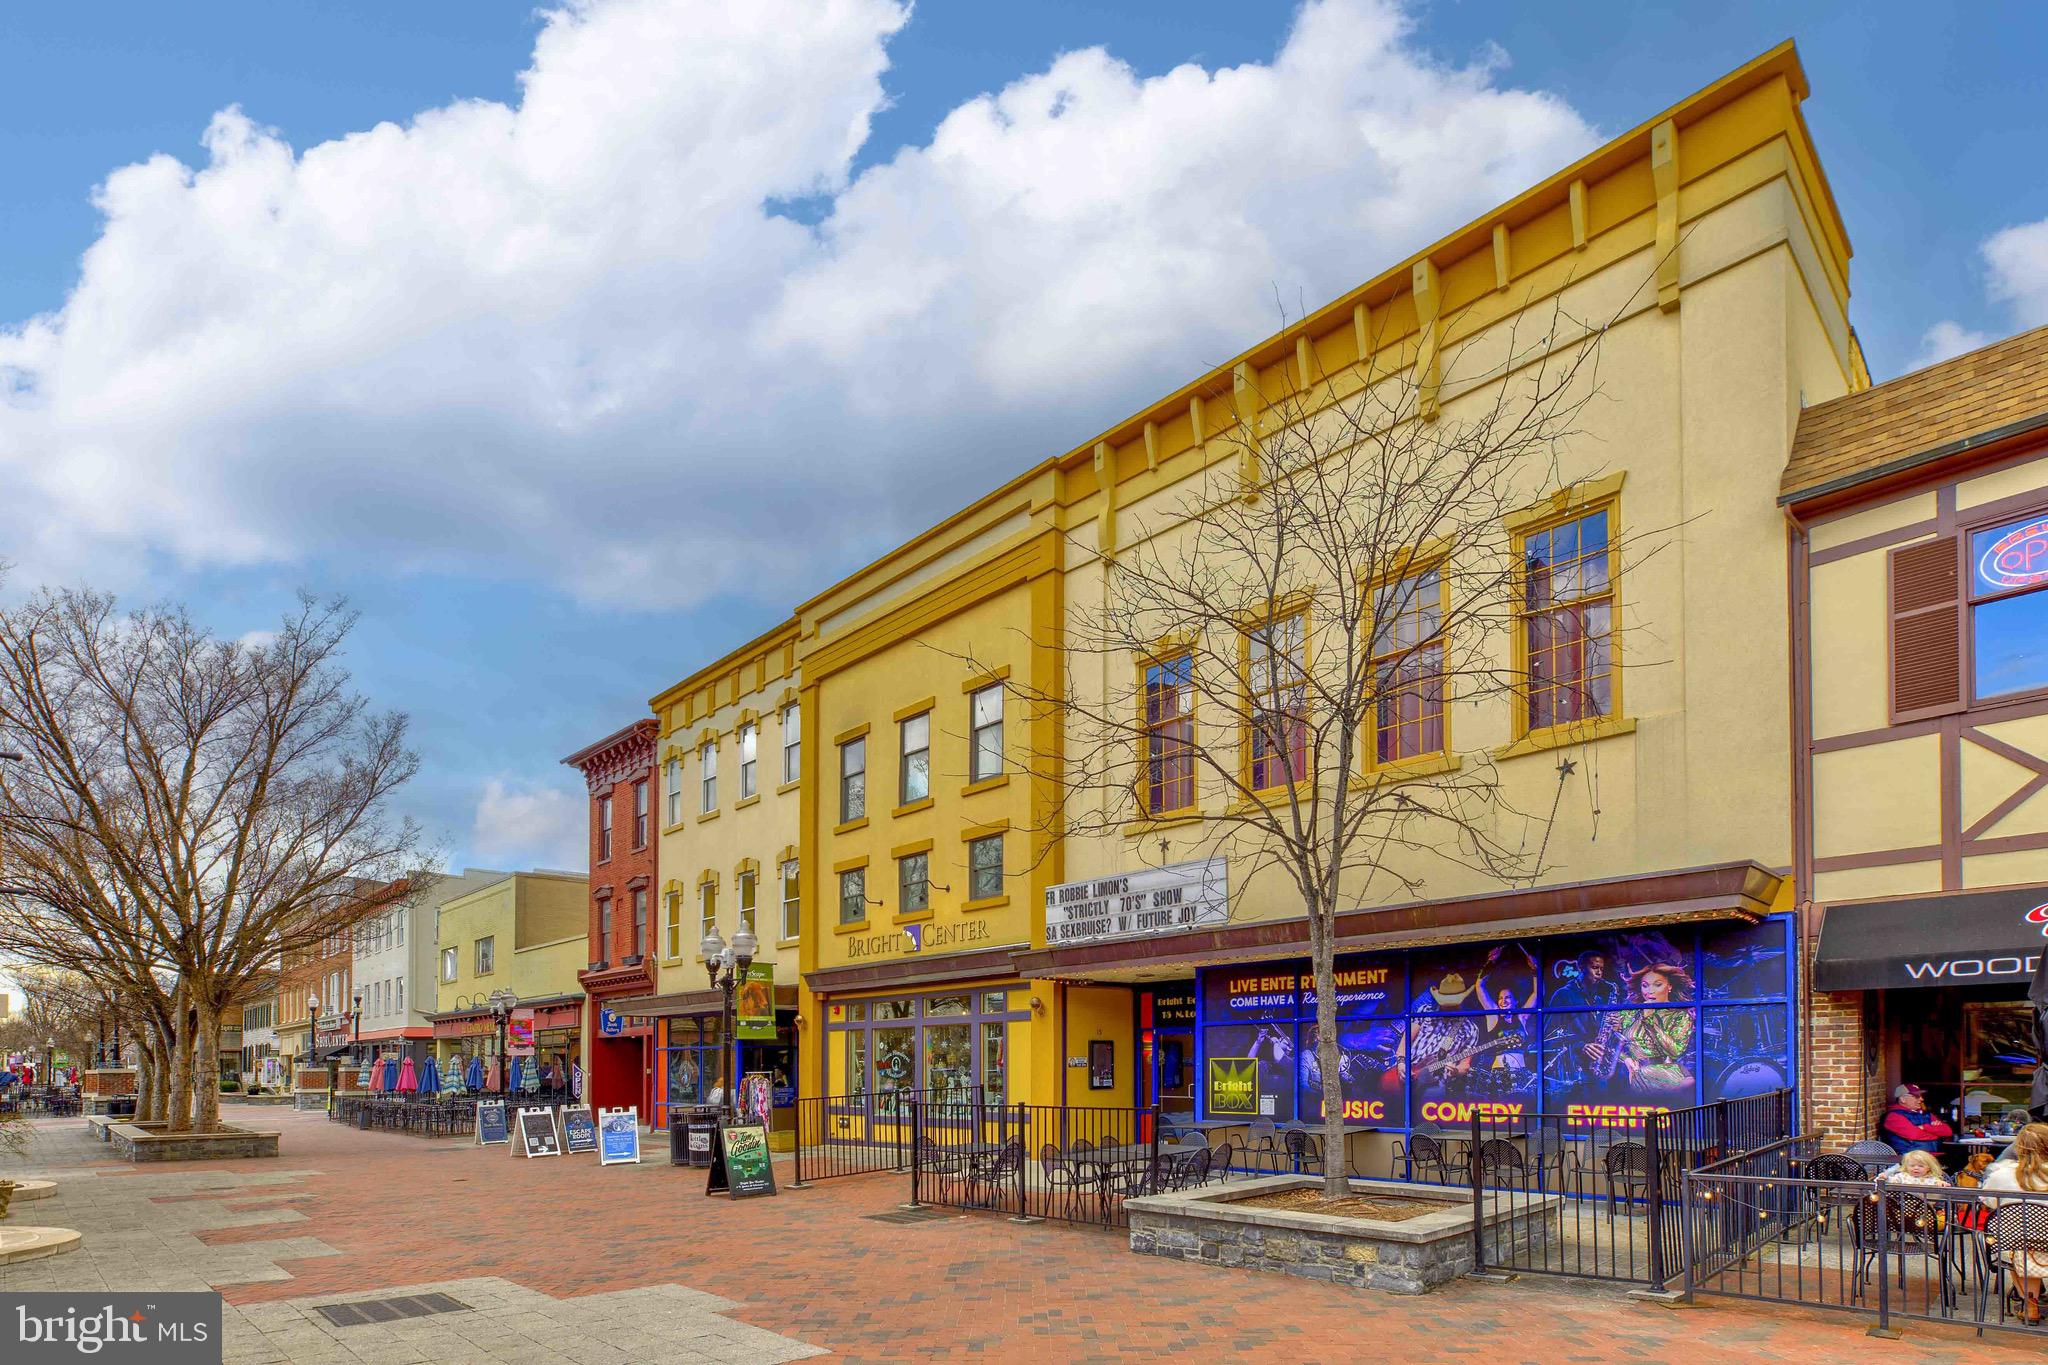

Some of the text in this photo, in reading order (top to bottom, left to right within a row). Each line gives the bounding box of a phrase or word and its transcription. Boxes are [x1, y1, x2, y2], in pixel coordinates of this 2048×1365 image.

[1045, 877, 1129, 905] FR ROBBIE LIMON'S
[1063, 900, 1110, 920] "STRICTLY
[1153, 888, 1183, 907] SHOW
[1046, 906, 1197, 941] SA SEXBRUISE? W/ FUTURE JOY
[847, 920, 990, 958] BRIGHT CENTER
[1230, 969, 1388, 994] LIVE ENTERTNMENT
[1157, 996, 1183, 1006] Bright
[1230, 997, 1260, 1008] COME
[1260, 995, 1285, 1006] HAVE
[1287, 995, 1294, 1005] A
[1335, 990, 1386, 1006] xperience
[574, 1071, 582, 1095] OPEN
[1213, 1080, 1254, 1092] Bright
[1213, 1093, 1254, 1110] BOX
[1321, 1100, 1384, 1120] USIC
[1421, 1102, 1523, 1124] COMEDY
